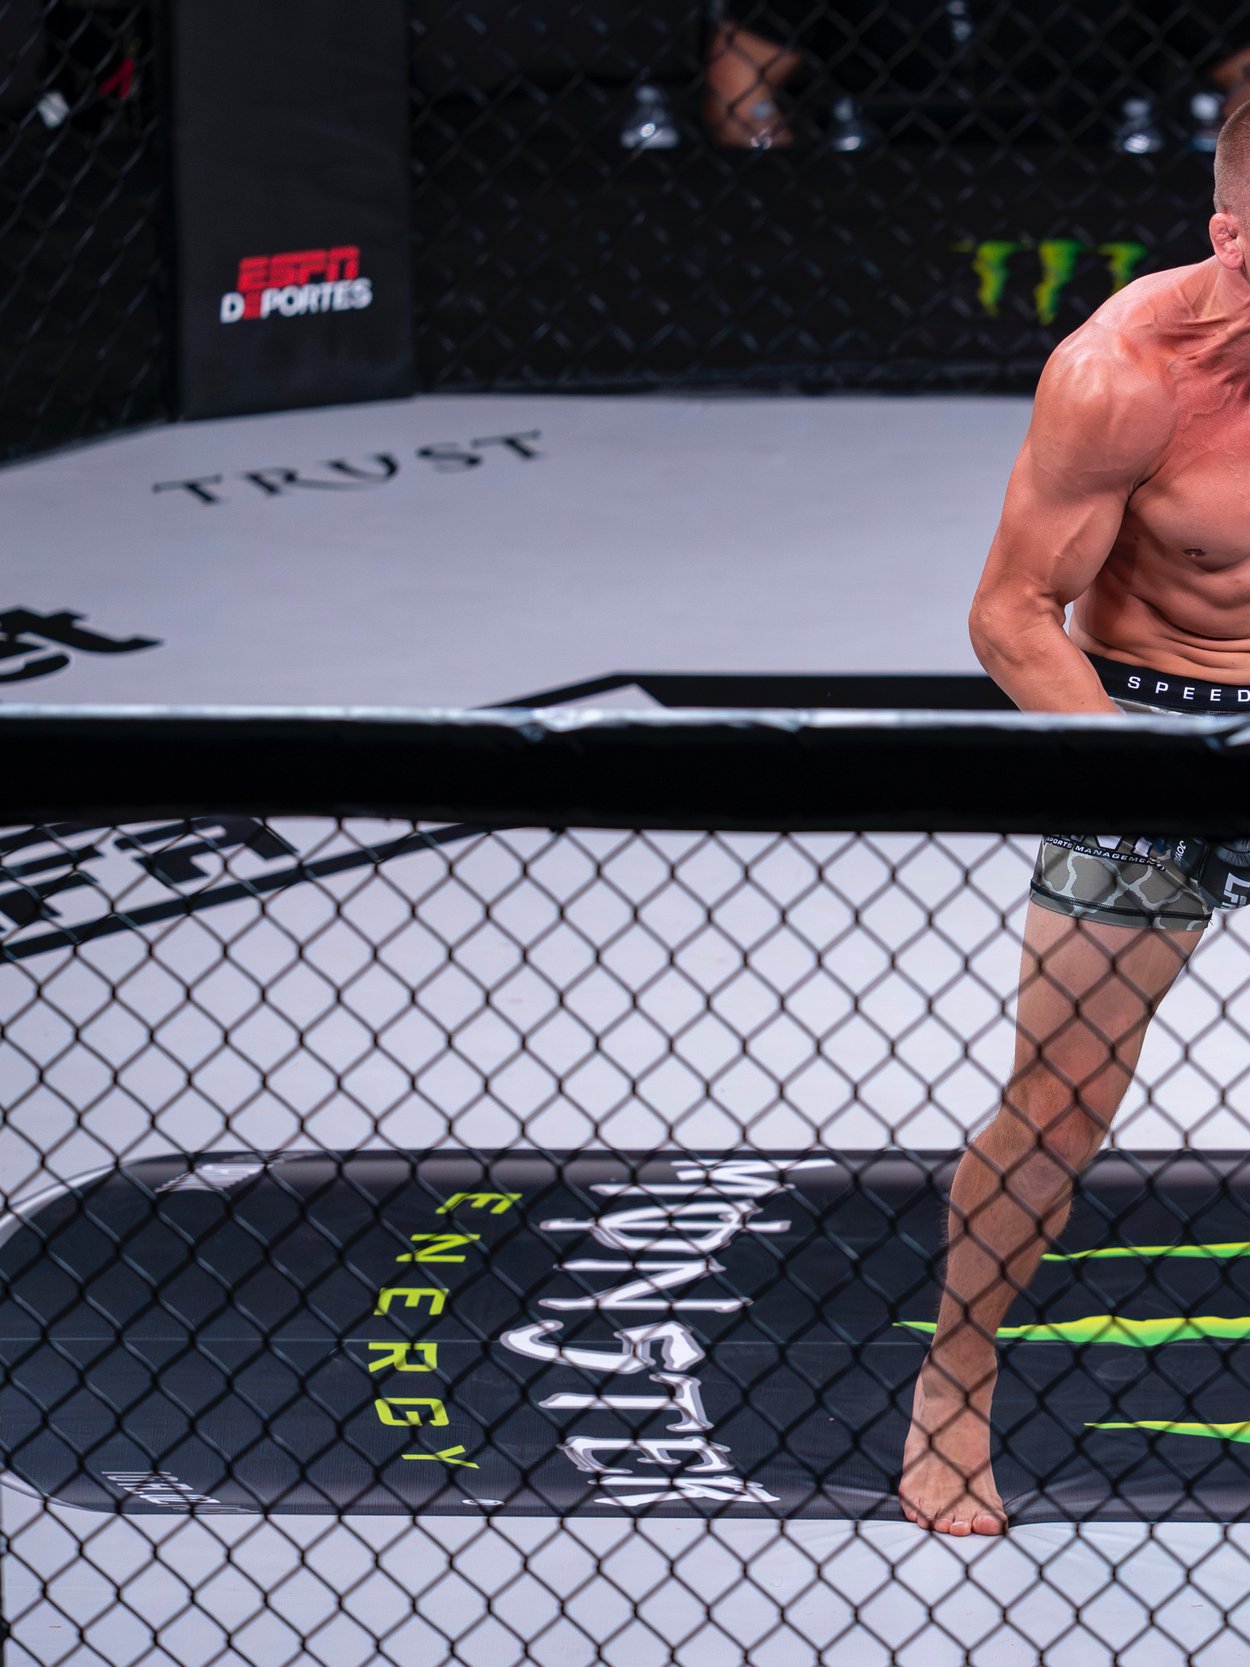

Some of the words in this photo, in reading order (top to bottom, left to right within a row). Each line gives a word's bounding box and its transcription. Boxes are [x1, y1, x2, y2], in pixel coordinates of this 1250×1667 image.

[237, 245, 361, 292] ESPN
[151, 429, 543, 504] TRUST
[368, 1192, 523, 1469] ENERGY
[500, 1158, 836, 1507] MONSTER
